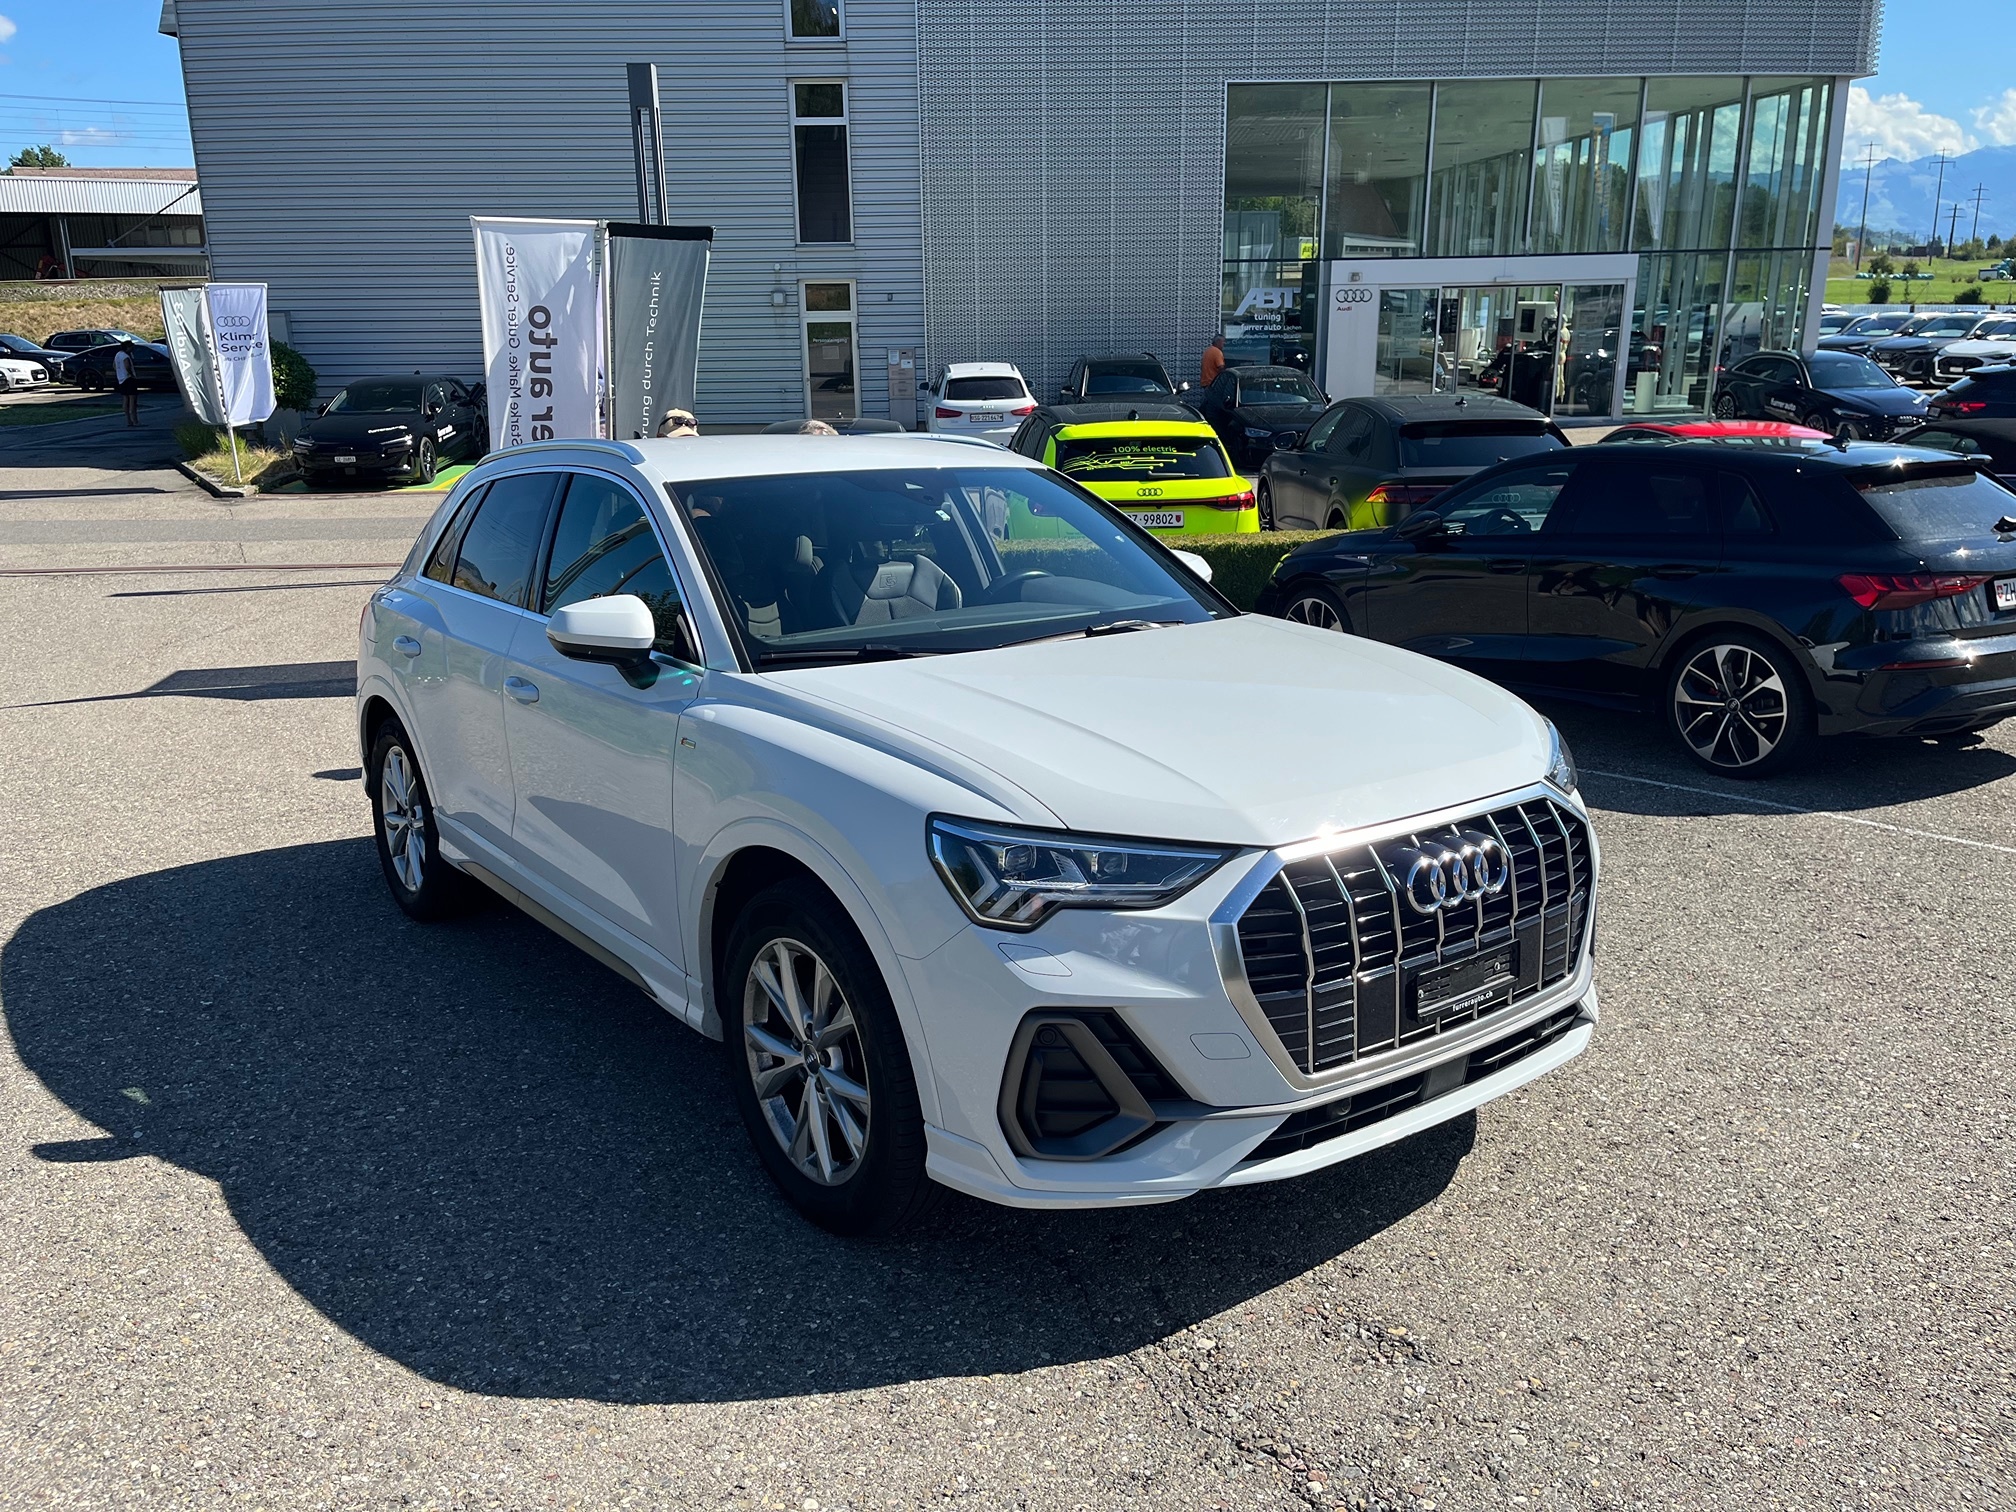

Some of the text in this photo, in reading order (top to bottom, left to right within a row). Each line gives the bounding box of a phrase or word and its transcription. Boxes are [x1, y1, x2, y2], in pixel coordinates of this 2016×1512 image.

[646, 271, 662, 337] Technik
[1233, 287, 1297, 316] ABT
[1254, 313, 1281, 323] tuning
[641, 340, 654, 390] durch
[1142, 445, 1177, 453] electric
[1452, 990, 1493, 1012] furrerauto.ch
